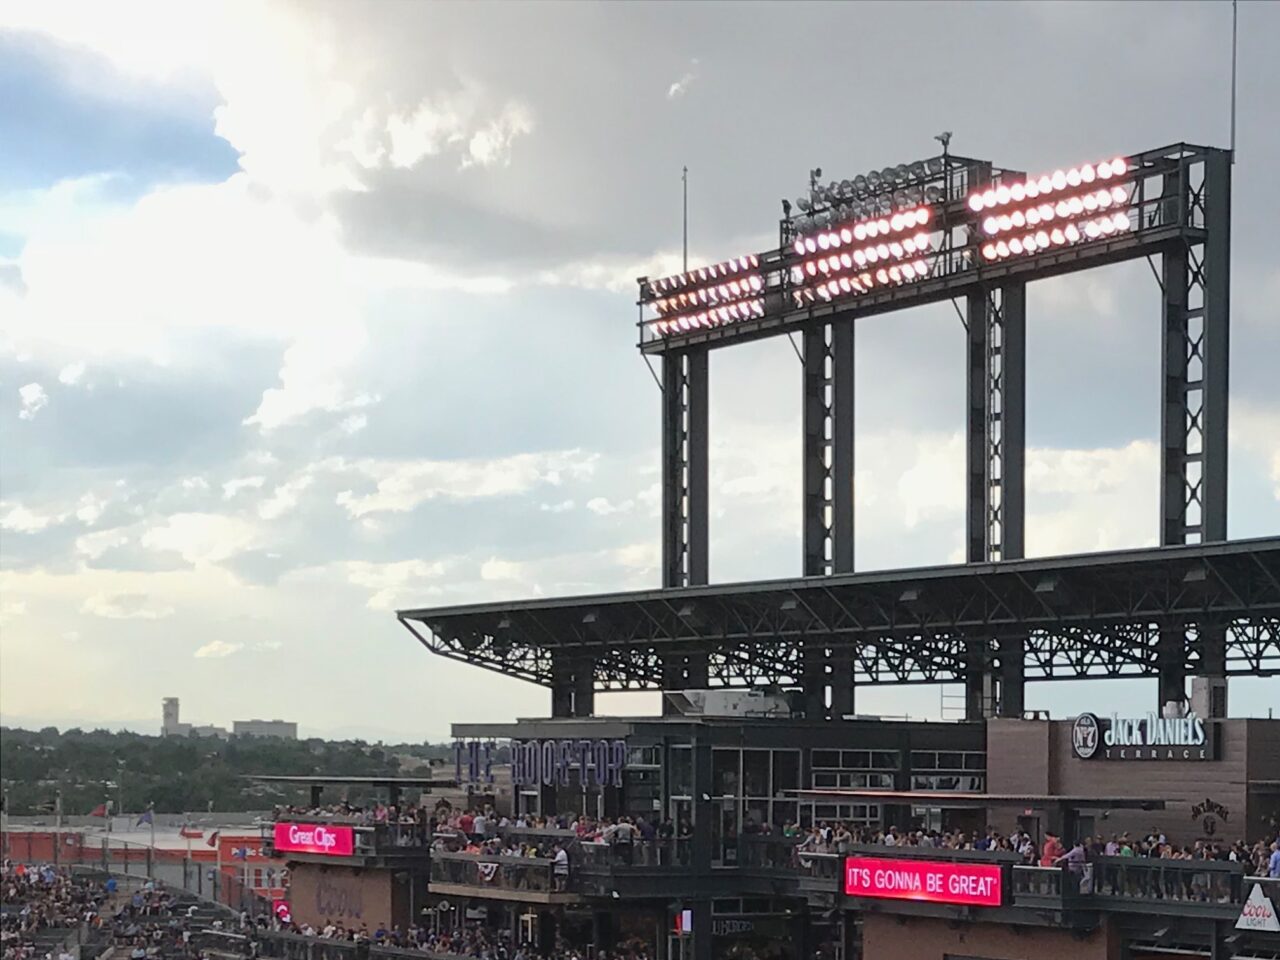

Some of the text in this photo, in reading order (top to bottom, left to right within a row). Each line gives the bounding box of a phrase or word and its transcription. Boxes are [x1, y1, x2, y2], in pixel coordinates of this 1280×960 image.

[1104, 711, 1205, 746] JACK DANIEL'S
[453, 740, 627, 788] THE ROOFTOP
[1106, 749, 1205, 759] TERRACE
[289, 825, 336, 852] Great Clips
[849, 868, 993, 896] IT'S GONNA BE GREAT
[1242, 902, 1272, 918] Coors
[1245, 918, 1267, 928] LIGHT
